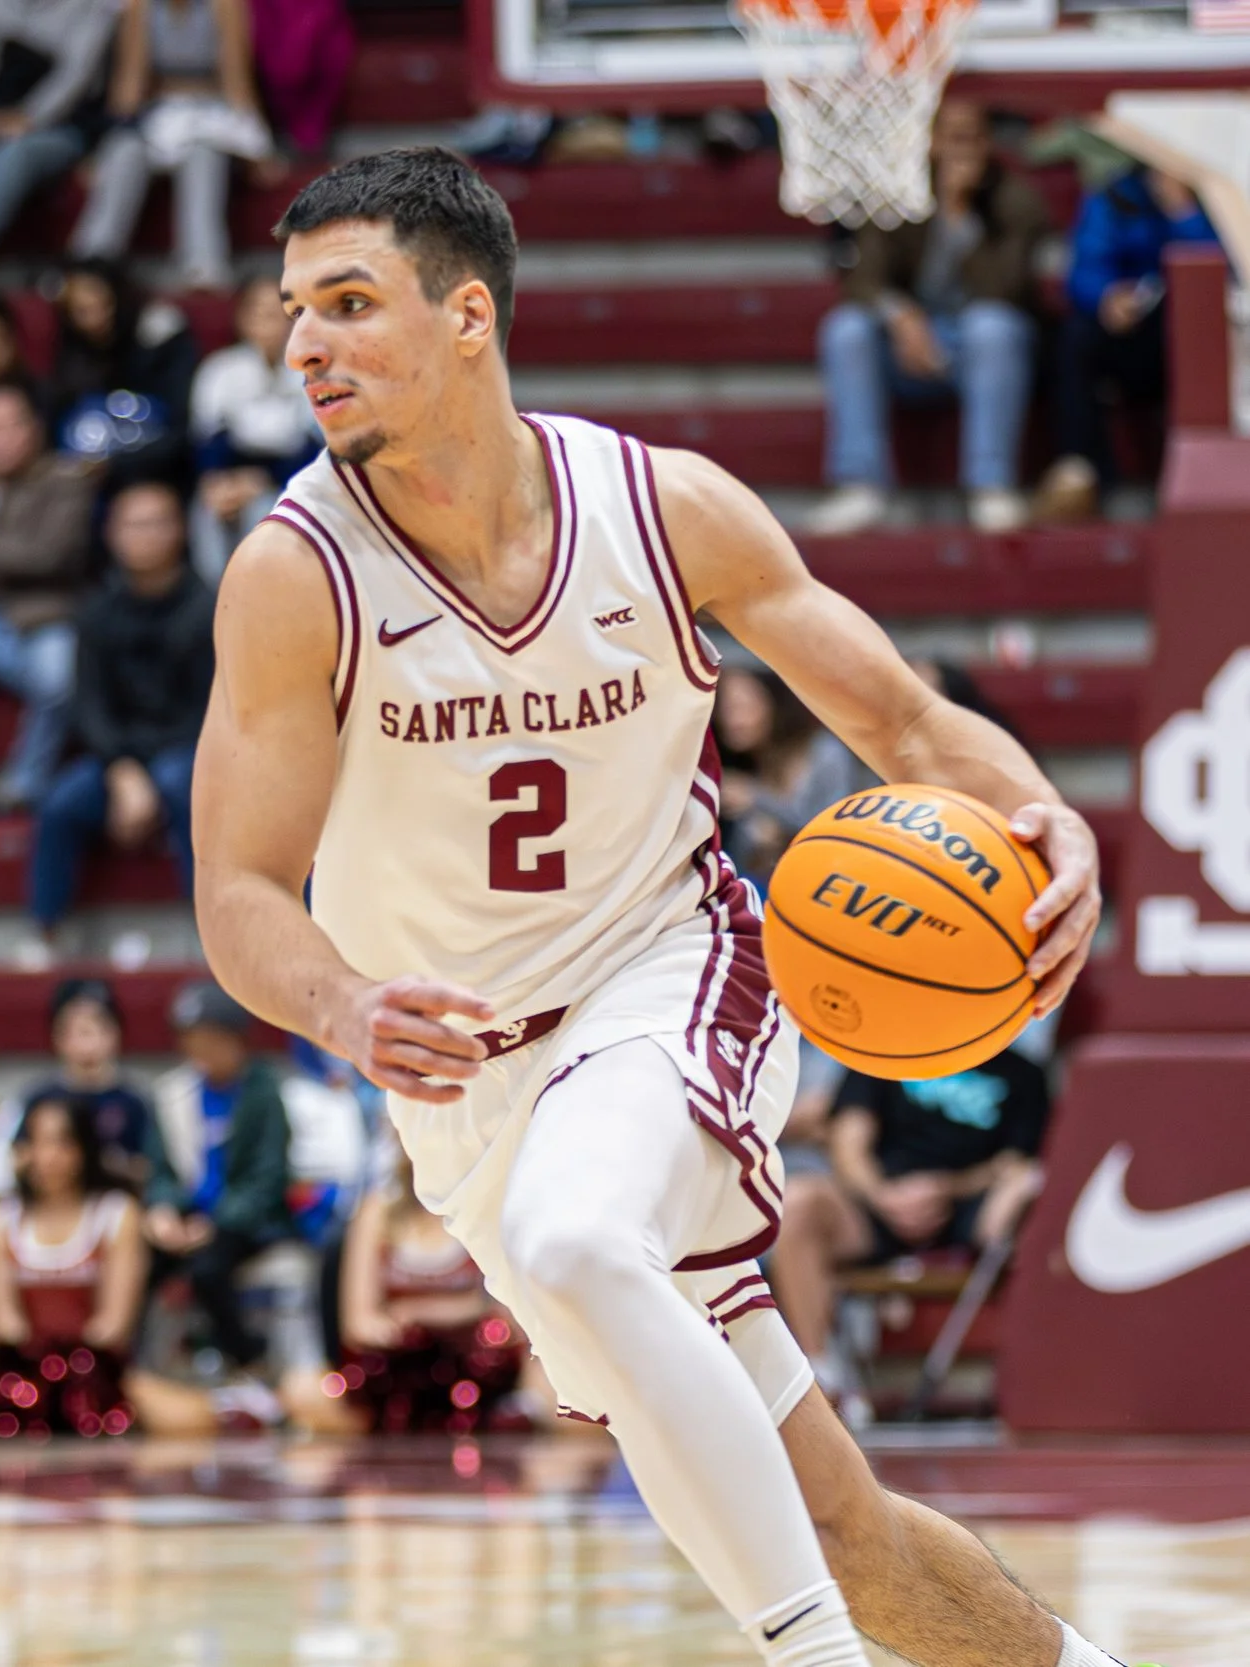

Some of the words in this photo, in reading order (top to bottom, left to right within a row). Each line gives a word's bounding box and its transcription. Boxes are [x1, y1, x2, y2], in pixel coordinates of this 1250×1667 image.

[380, 694, 510, 743] SANTA
[523, 668, 646, 732] CLARA
[489, 758, 566, 893] 2
[833, 795, 1003, 896] Wilson
[810, 872, 925, 938] EVO
